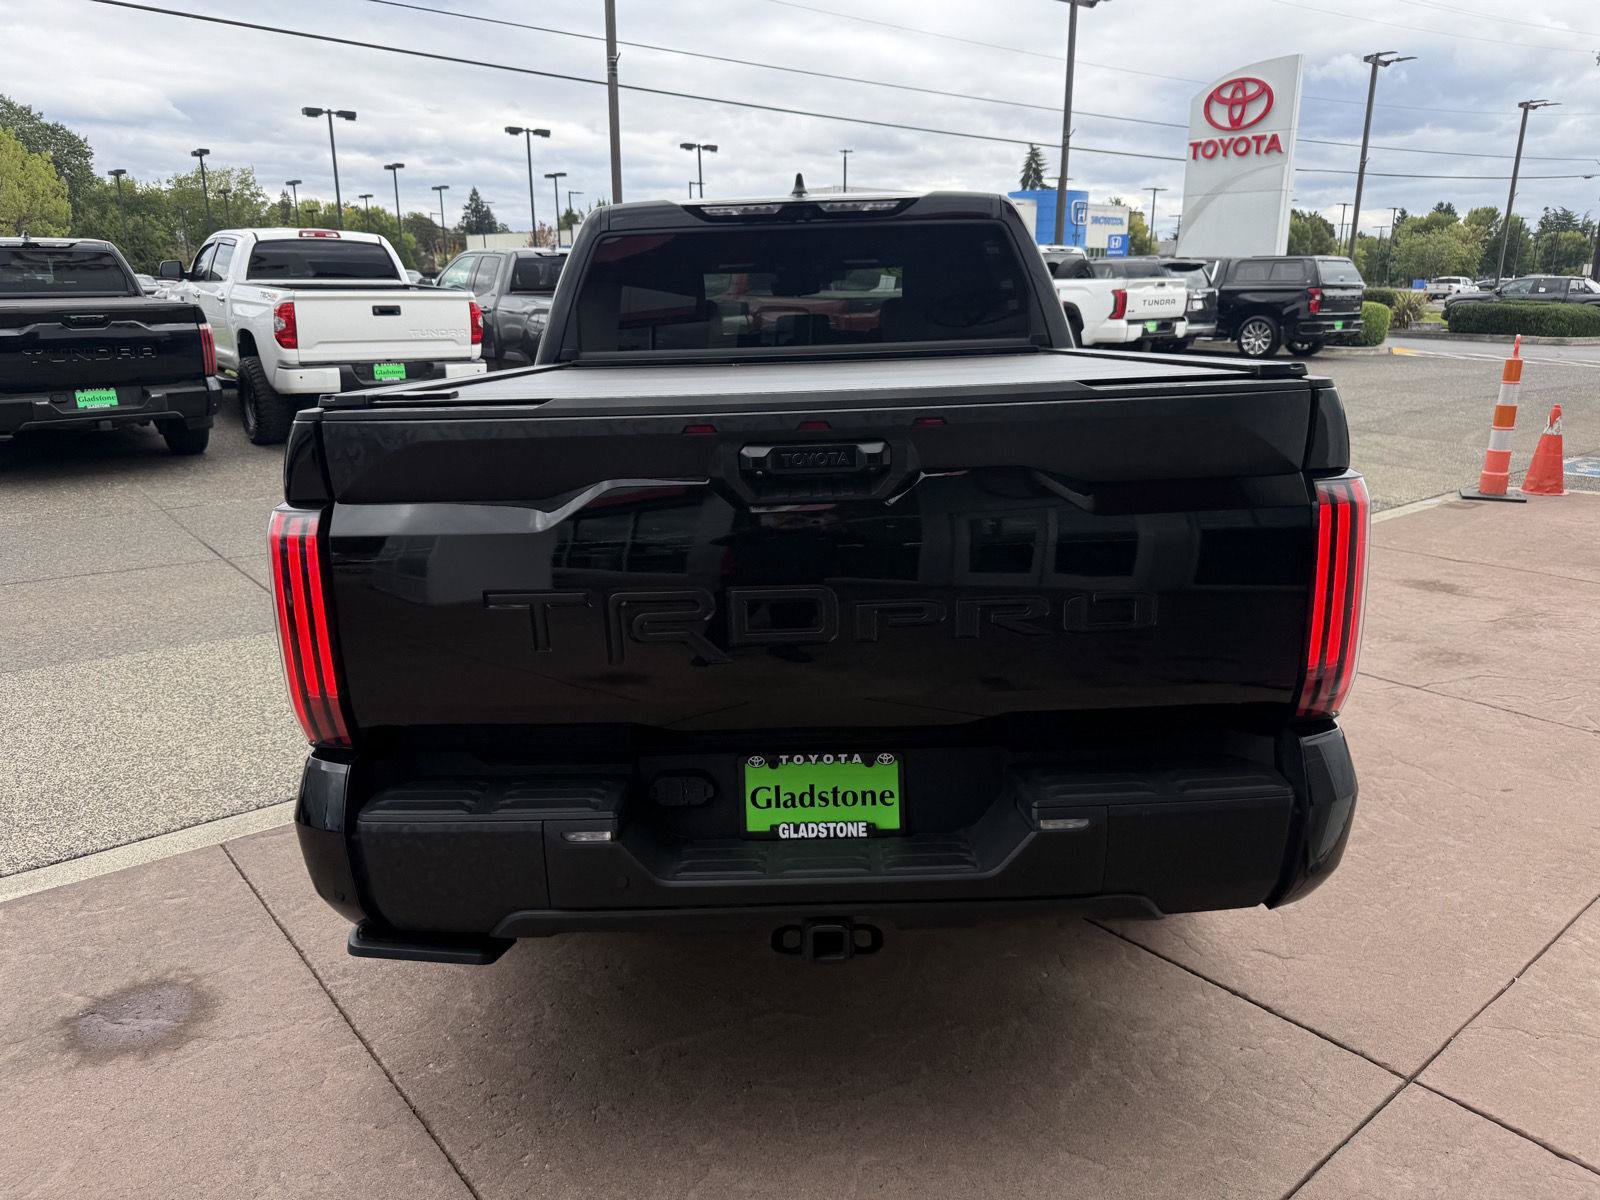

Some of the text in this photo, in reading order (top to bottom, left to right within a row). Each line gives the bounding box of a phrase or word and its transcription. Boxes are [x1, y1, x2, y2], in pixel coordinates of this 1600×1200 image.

[1189, 133, 1284, 161] TOYOTA
[1142, 298, 1176, 306] TUNDRA
[408, 328, 466, 339] TUNDRA
[22, 344, 157, 366] TUNDRA
[77, 395, 116, 403] Gladstone
[780, 452, 850, 467] TOYOTA
[779, 753, 863, 765] TOYOTA
[750, 784, 896, 809] Gladstone
[778, 821, 868, 839] GLADSTONE
